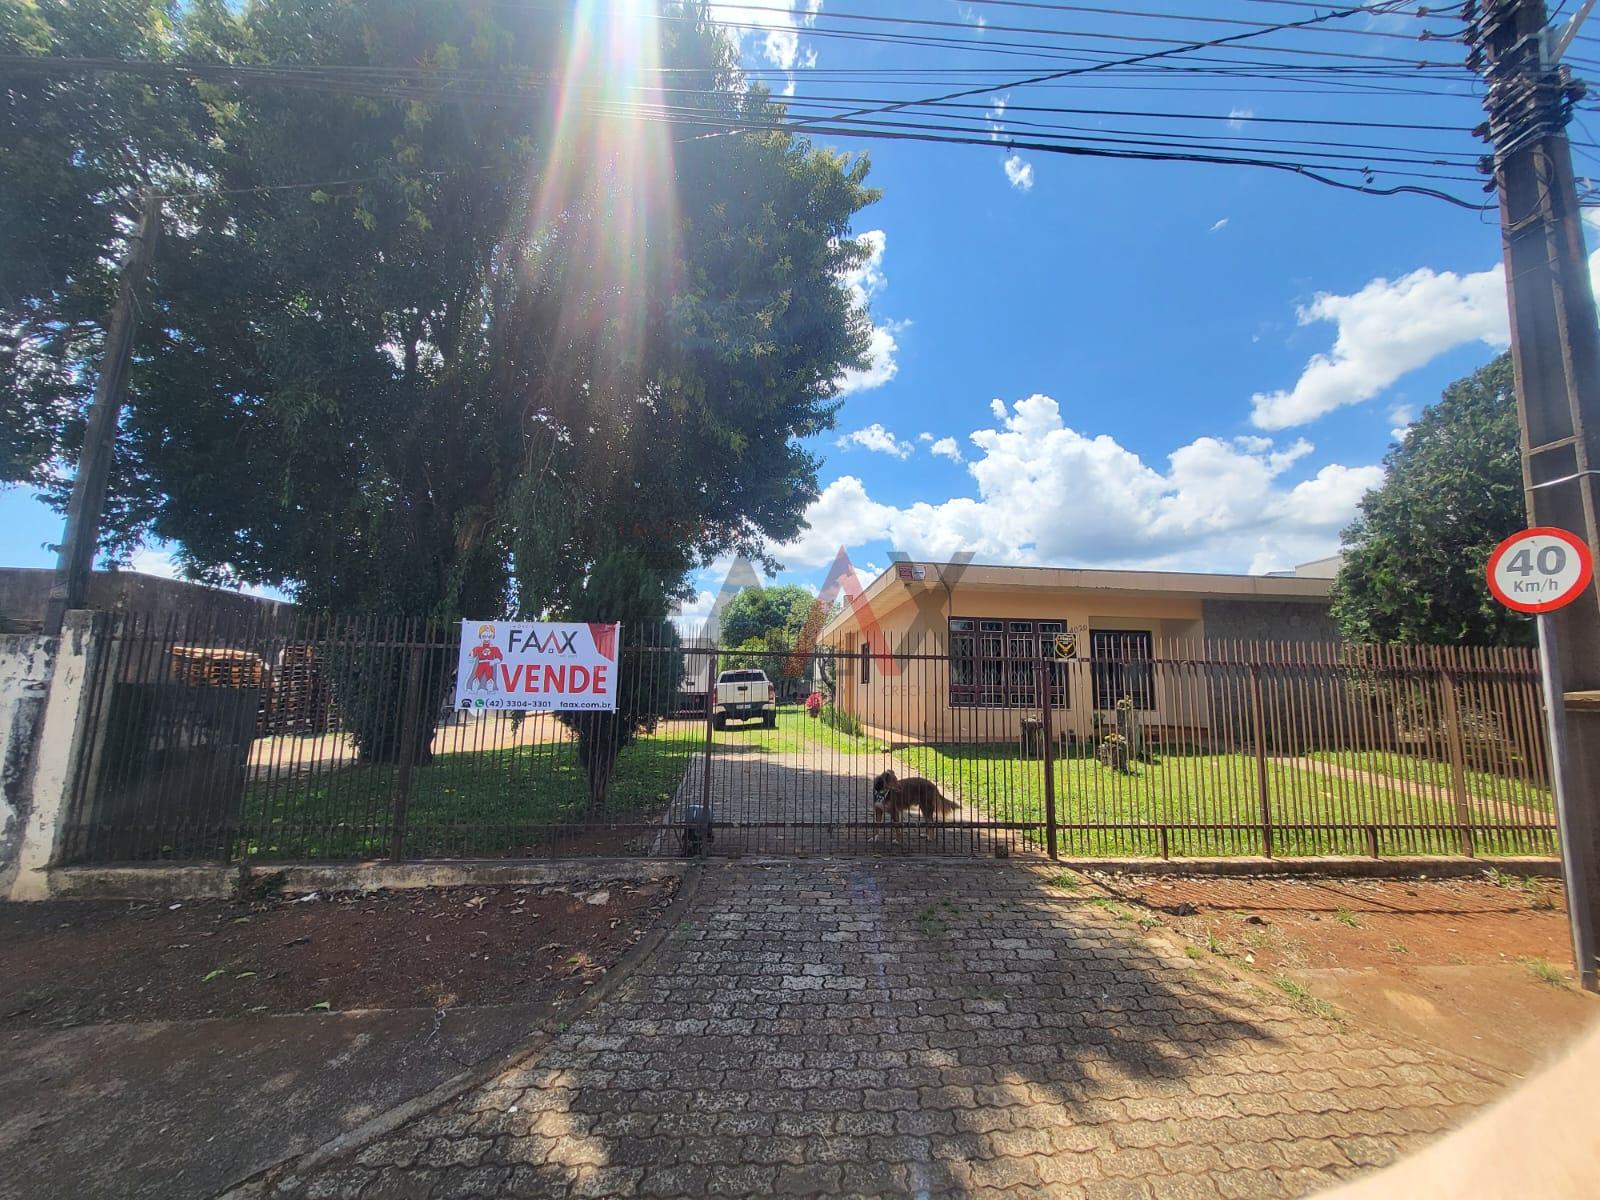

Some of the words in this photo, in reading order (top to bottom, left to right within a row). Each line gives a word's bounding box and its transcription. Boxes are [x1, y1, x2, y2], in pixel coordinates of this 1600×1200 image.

[1506, 545, 1567, 577] 40
[1513, 578, 1558, 593] Km/h
[501, 664, 608, 694] VENDE
[485, 698, 503, 708] (42)
[506, 700, 551, 708] 3304-3301
